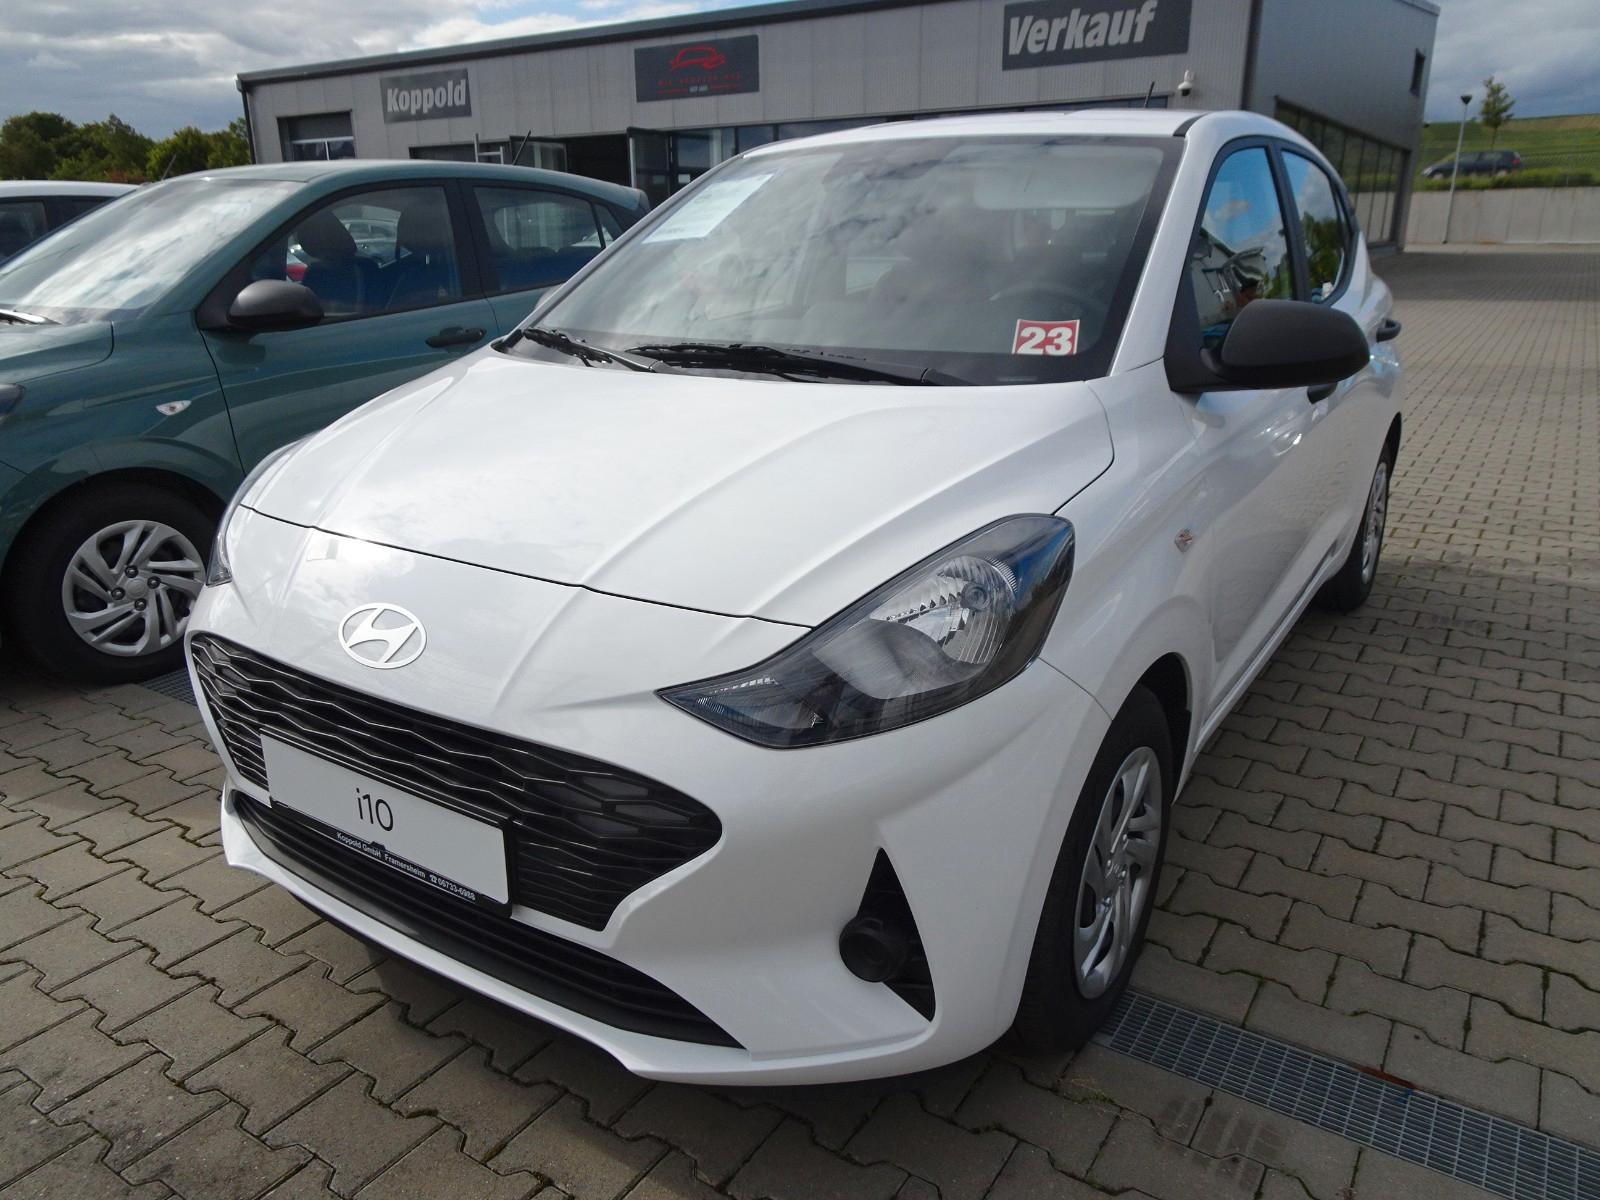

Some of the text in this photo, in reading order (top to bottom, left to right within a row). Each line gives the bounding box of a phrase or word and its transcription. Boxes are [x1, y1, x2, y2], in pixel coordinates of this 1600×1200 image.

[1008, 0, 1159, 56] Verkauf
[387, 79, 467, 115] Koppold
[1016, 326, 1073, 356] 23
[355, 787, 394, 832] i10
[336, 831, 362, 849] Koppold
[362, 843, 382, 859] GmbH
[384, 853, 426, 879] Framersheim
